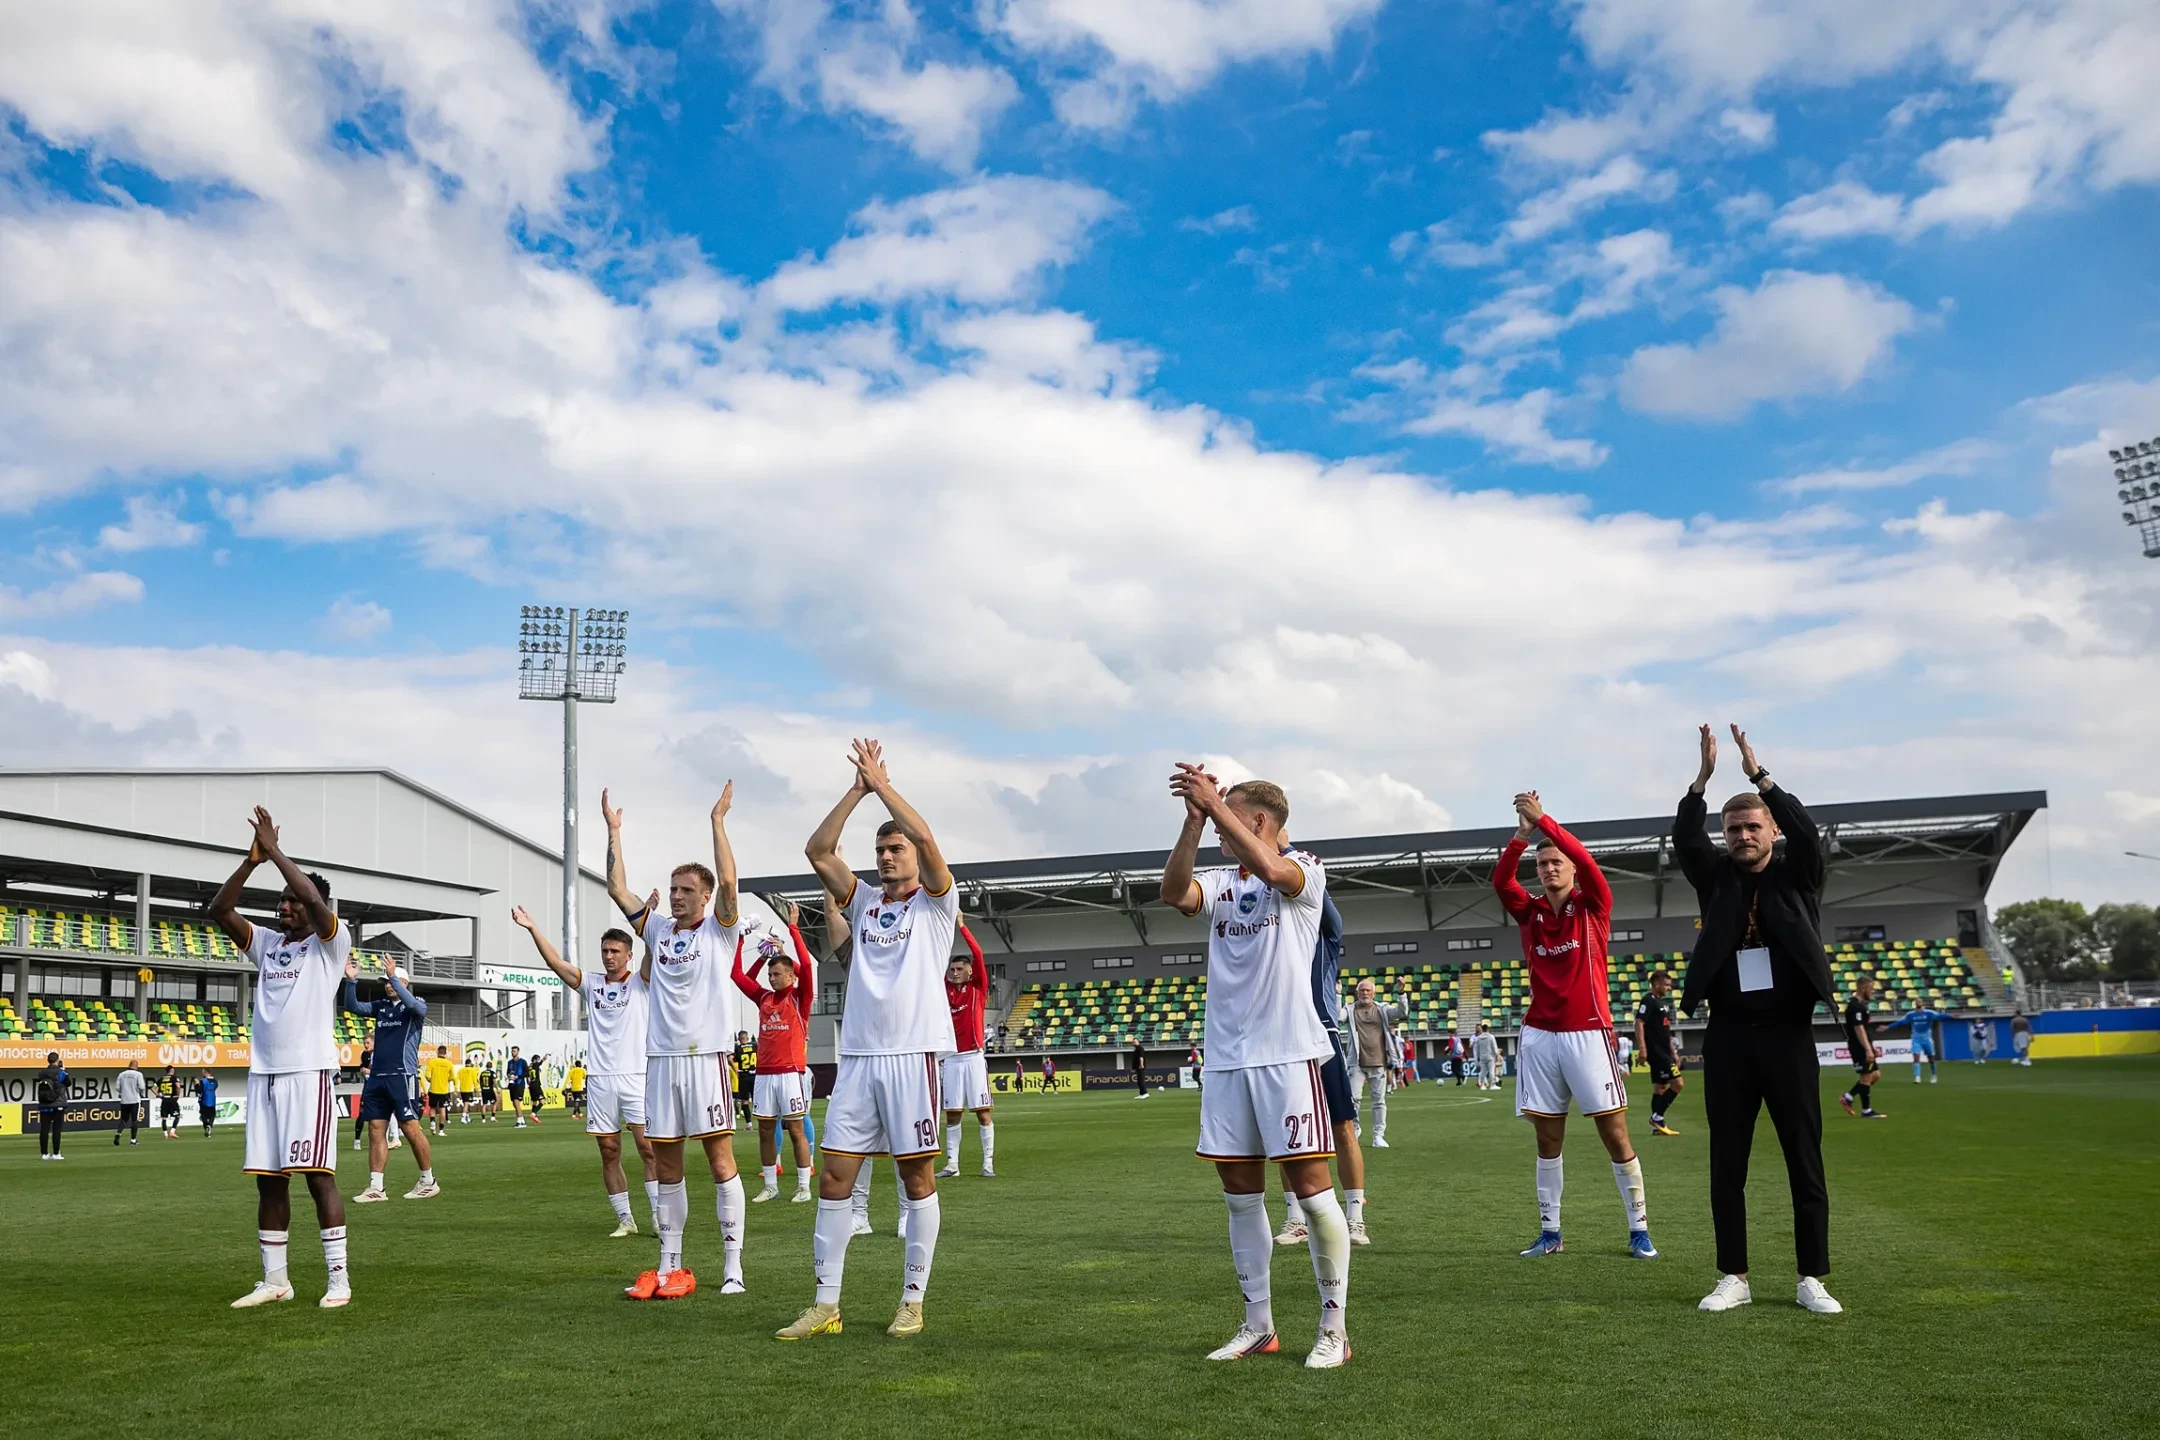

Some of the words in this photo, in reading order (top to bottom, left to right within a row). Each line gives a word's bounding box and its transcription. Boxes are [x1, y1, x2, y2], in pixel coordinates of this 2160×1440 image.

[138, 967, 153, 983] 10
[502, 973, 535, 985] АРЕНА
[91, 1045, 147, 1059] компанія
[227, 1048, 250, 1061] там,
[741, 1052, 757, 1070] 24
[1085, 1073, 1130, 1084] Financial
[27, 1109, 88, 1124] Ficial
[89, 1107, 122, 1121] Grou
[706, 1103, 725, 1128] 13
[913, 1118, 936, 1149] 19
[1284, 1112, 1314, 1150] 27
[289, 1139, 312, 1164] 98
